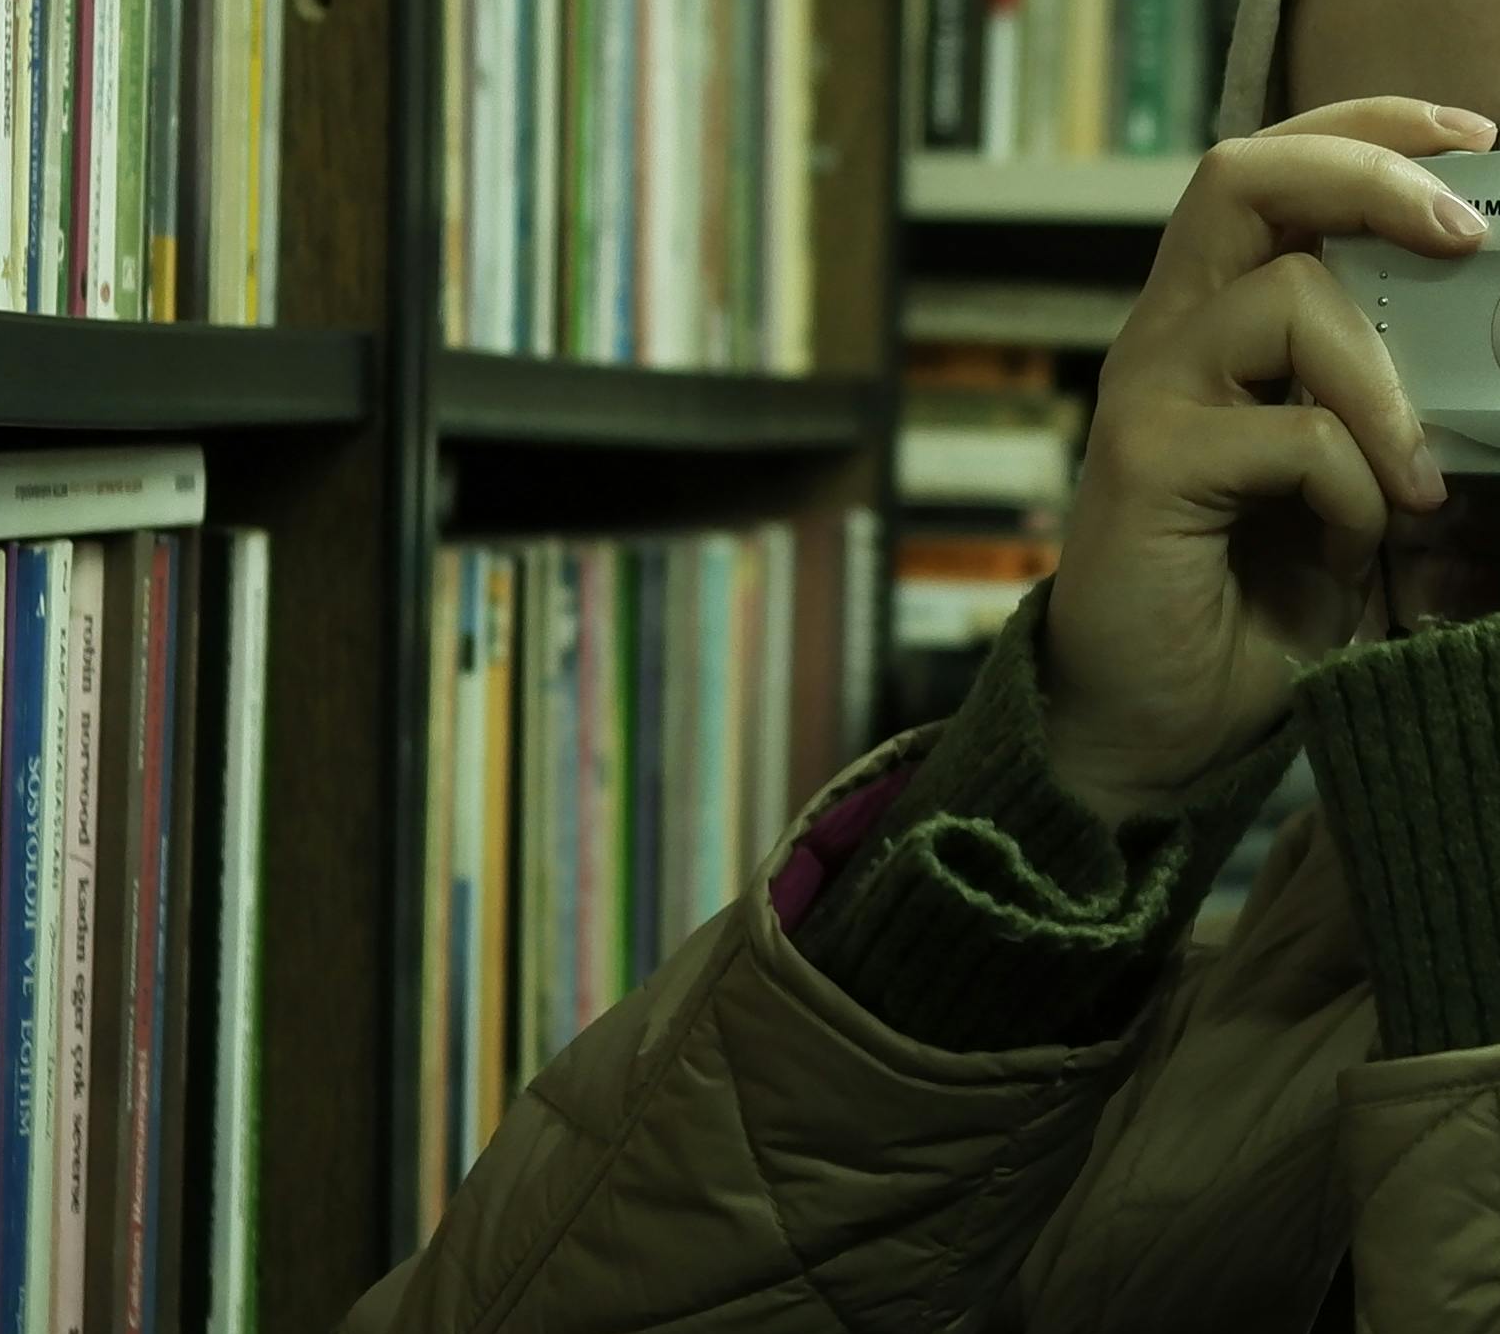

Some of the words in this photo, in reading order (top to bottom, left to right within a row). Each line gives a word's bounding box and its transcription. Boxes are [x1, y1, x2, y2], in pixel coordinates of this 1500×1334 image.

[83, 614, 95, 694] robin
[78, 711, 93, 845] norwood
[76, 876, 90, 963] kadın
[22, 954, 36, 997] VE
[71, 973, 87, 1034] eğer
[70, 1044, 85, 1100] çok
[70, 1113, 83, 1215] severse
